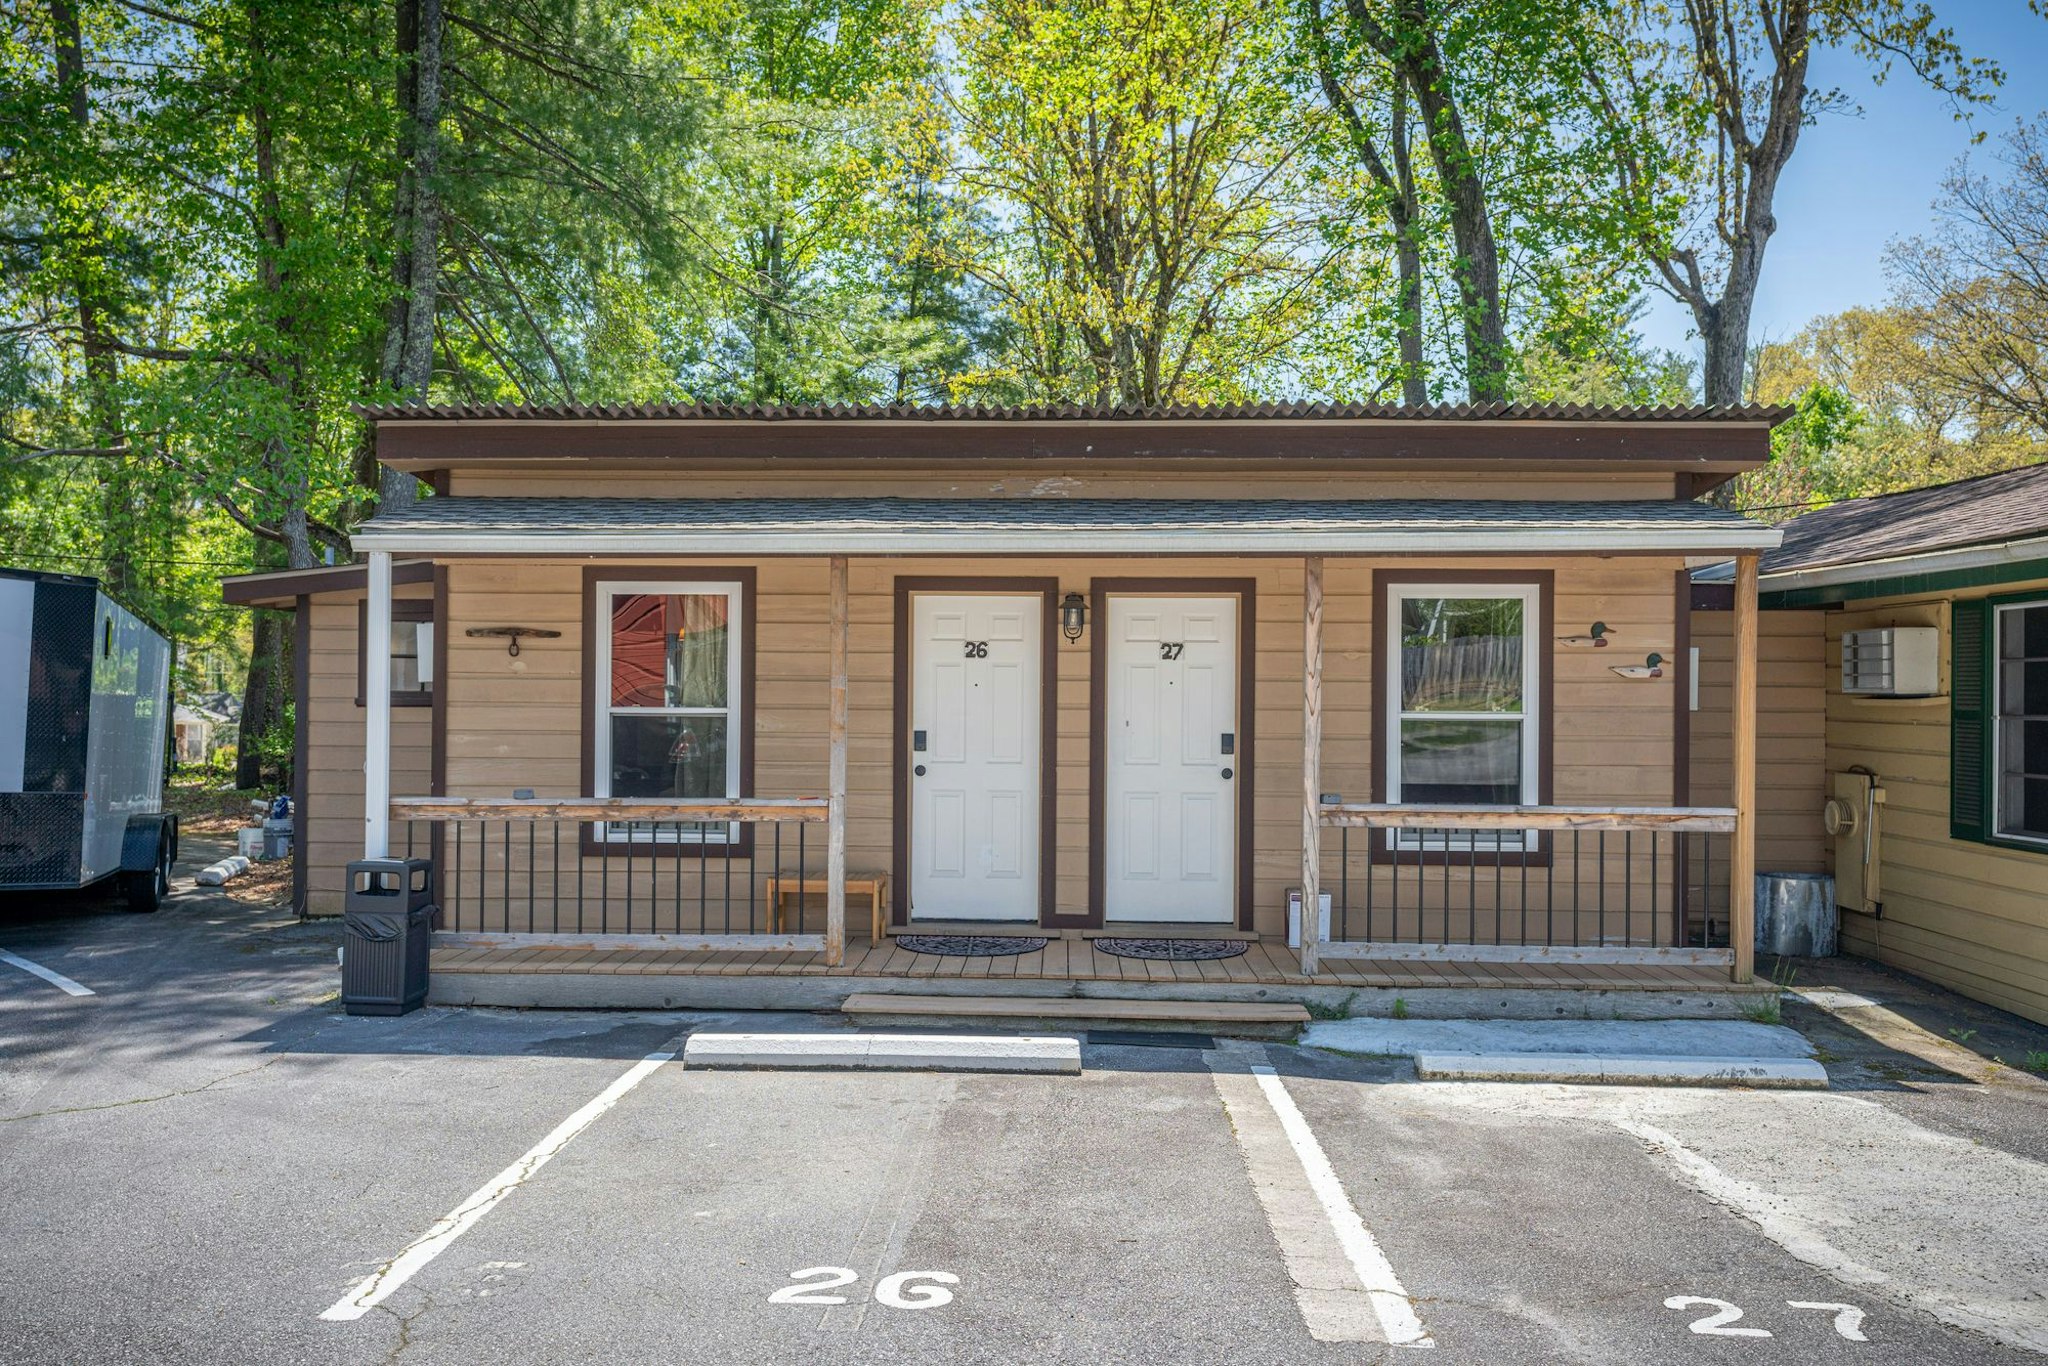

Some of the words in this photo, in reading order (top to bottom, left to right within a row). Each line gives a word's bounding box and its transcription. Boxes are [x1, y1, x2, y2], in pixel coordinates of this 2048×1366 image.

[964, 641, 989, 659] 26
[1160, 642, 1184, 661] 27
[767, 1266, 961, 1310] 26
[1663, 1295, 1869, 1342] 27
